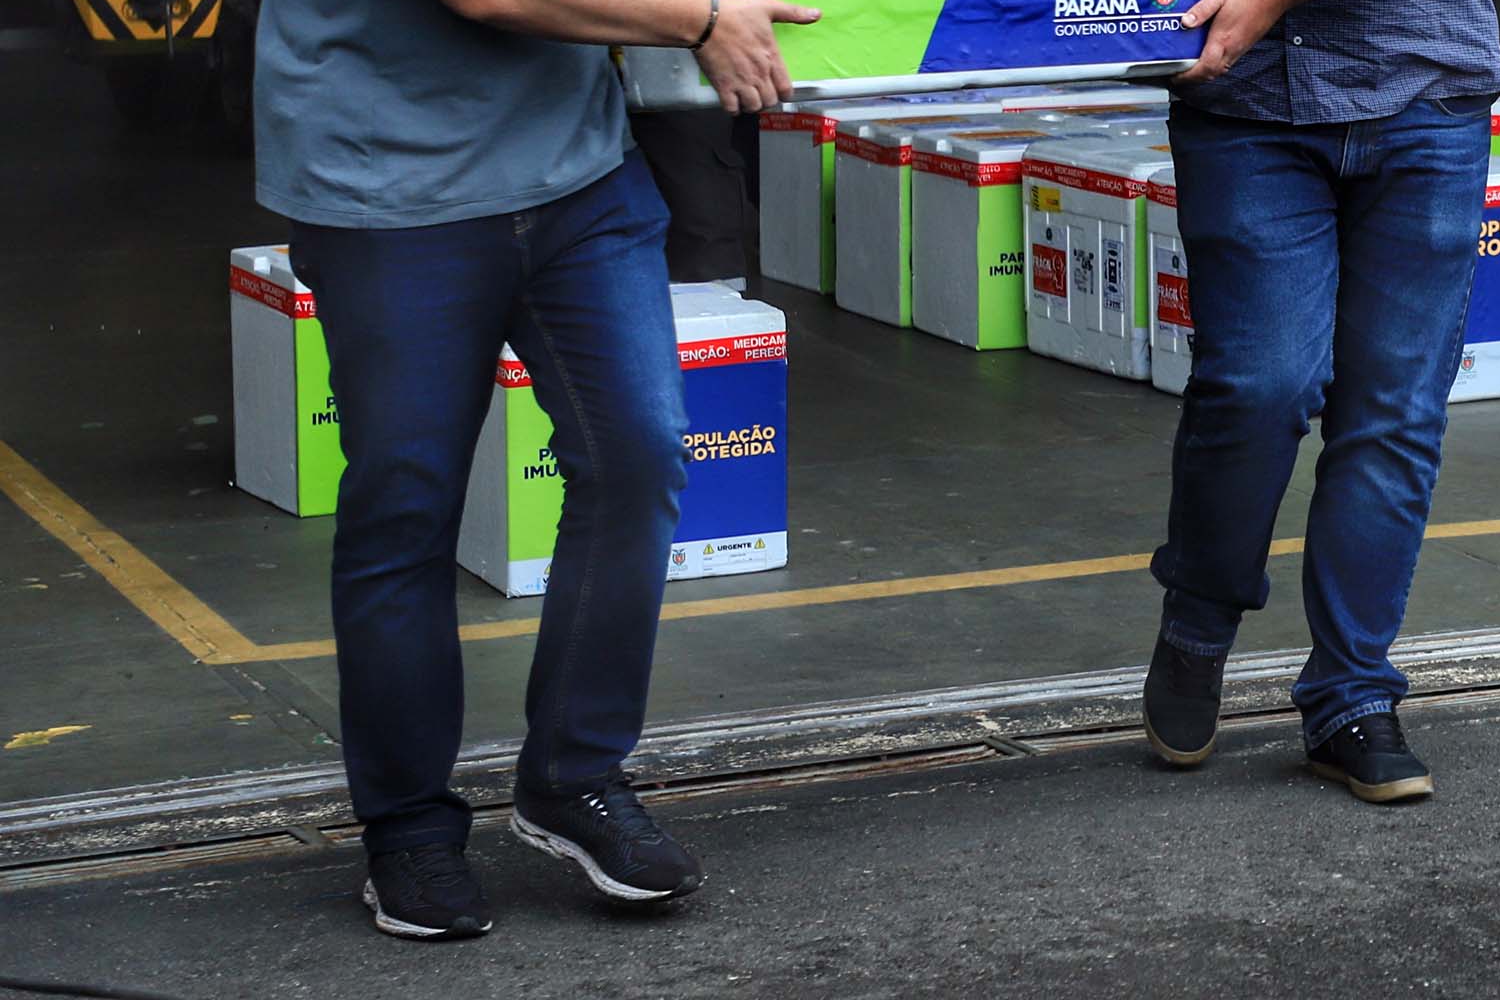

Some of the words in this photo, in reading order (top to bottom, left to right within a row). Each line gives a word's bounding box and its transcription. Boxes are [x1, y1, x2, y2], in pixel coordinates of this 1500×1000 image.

[1055, 22, 1117, 37] GOVERNO
[1120, 21, 1139, 34] DO
[690, 440, 776, 462] OTEGIDA
[717, 542, 753, 552] URGENTE
